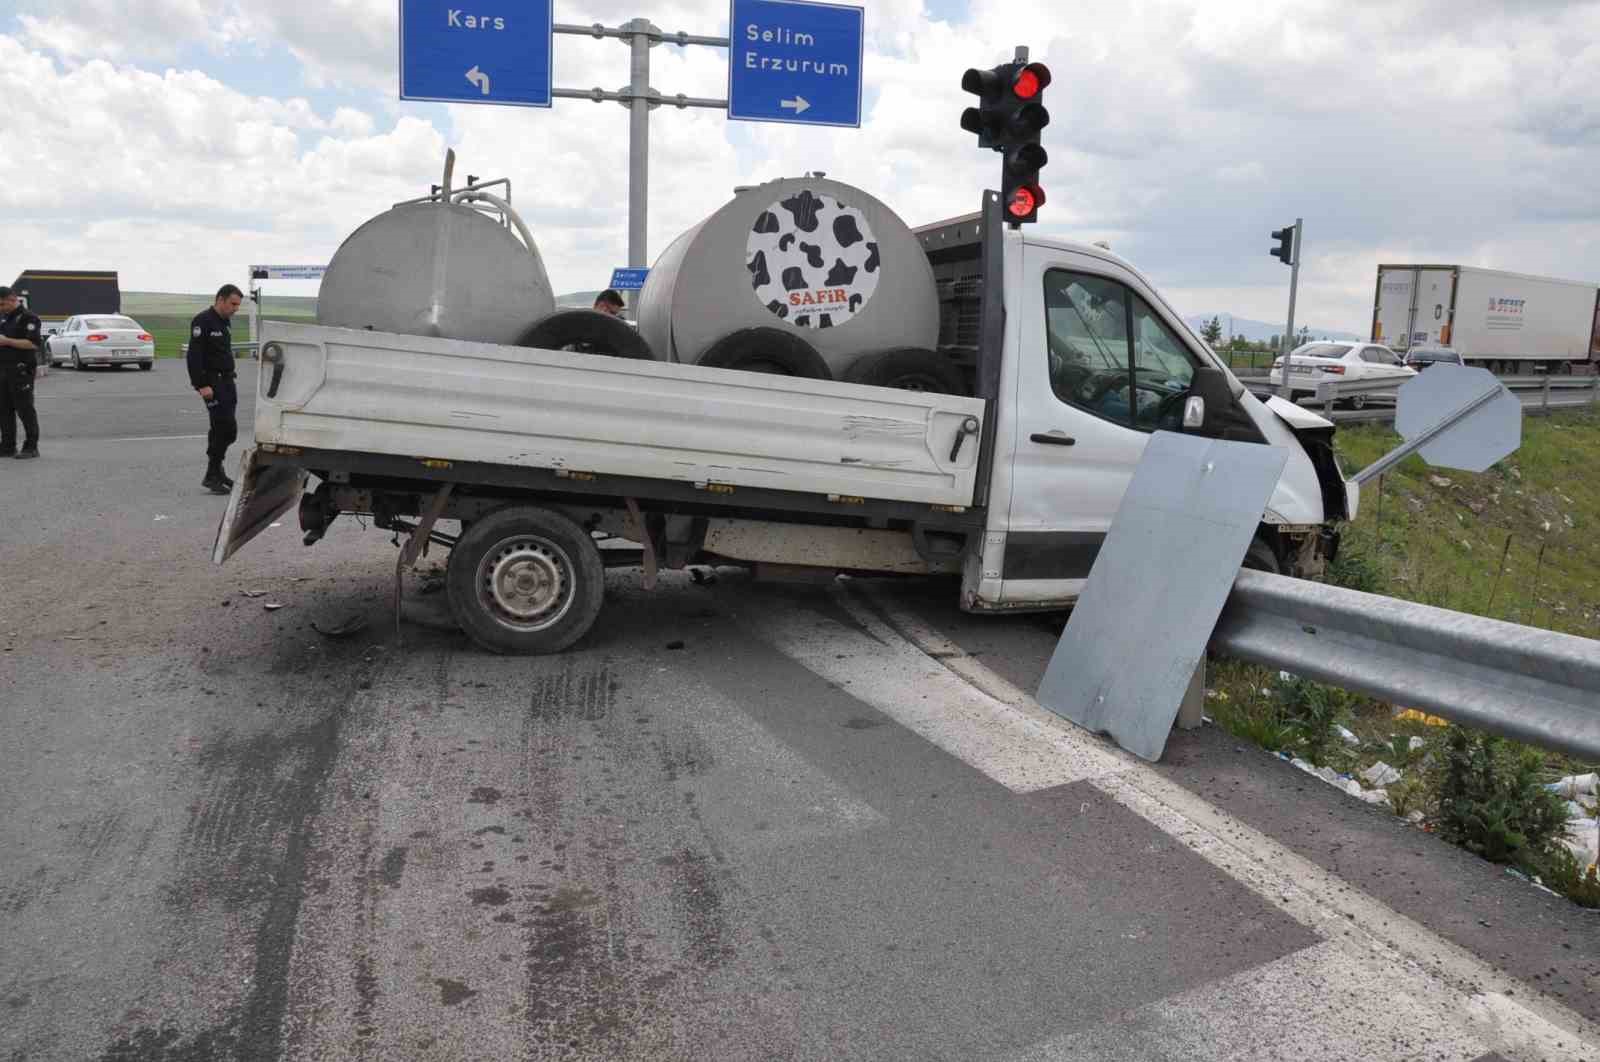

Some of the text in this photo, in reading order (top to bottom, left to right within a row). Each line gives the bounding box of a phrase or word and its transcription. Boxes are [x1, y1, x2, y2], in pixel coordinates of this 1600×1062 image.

[447, 9, 505, 30] Kars
[746, 23, 815, 47] Selim
[745, 51, 849, 76] Erzurum
